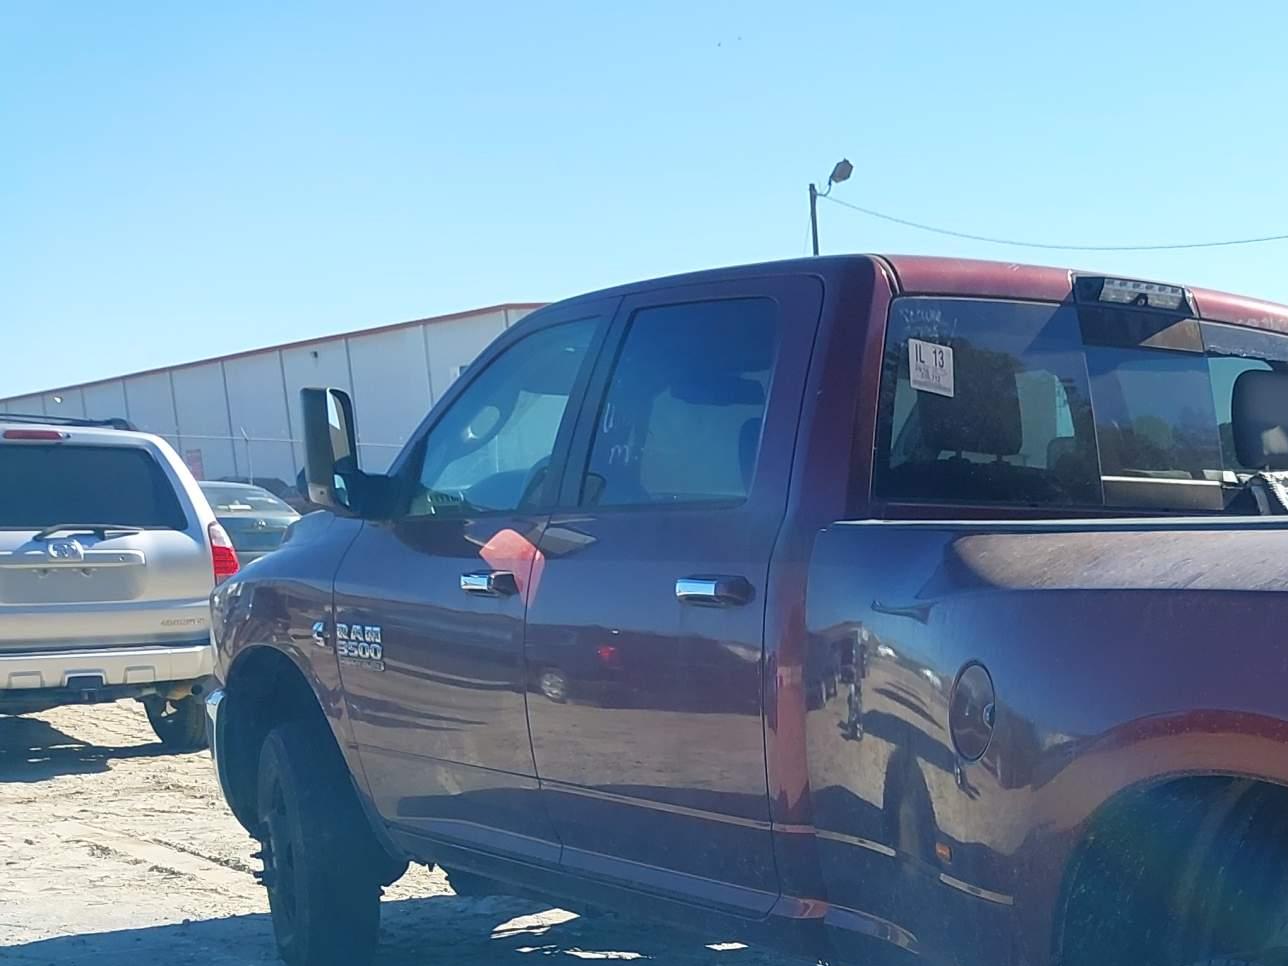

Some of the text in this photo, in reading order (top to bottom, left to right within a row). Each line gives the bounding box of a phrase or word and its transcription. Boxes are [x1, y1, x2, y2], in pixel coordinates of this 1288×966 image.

[914, 343, 945, 369] IL 13
[336, 623, 382, 643] RAM
[337, 640, 382, 660] 3500
